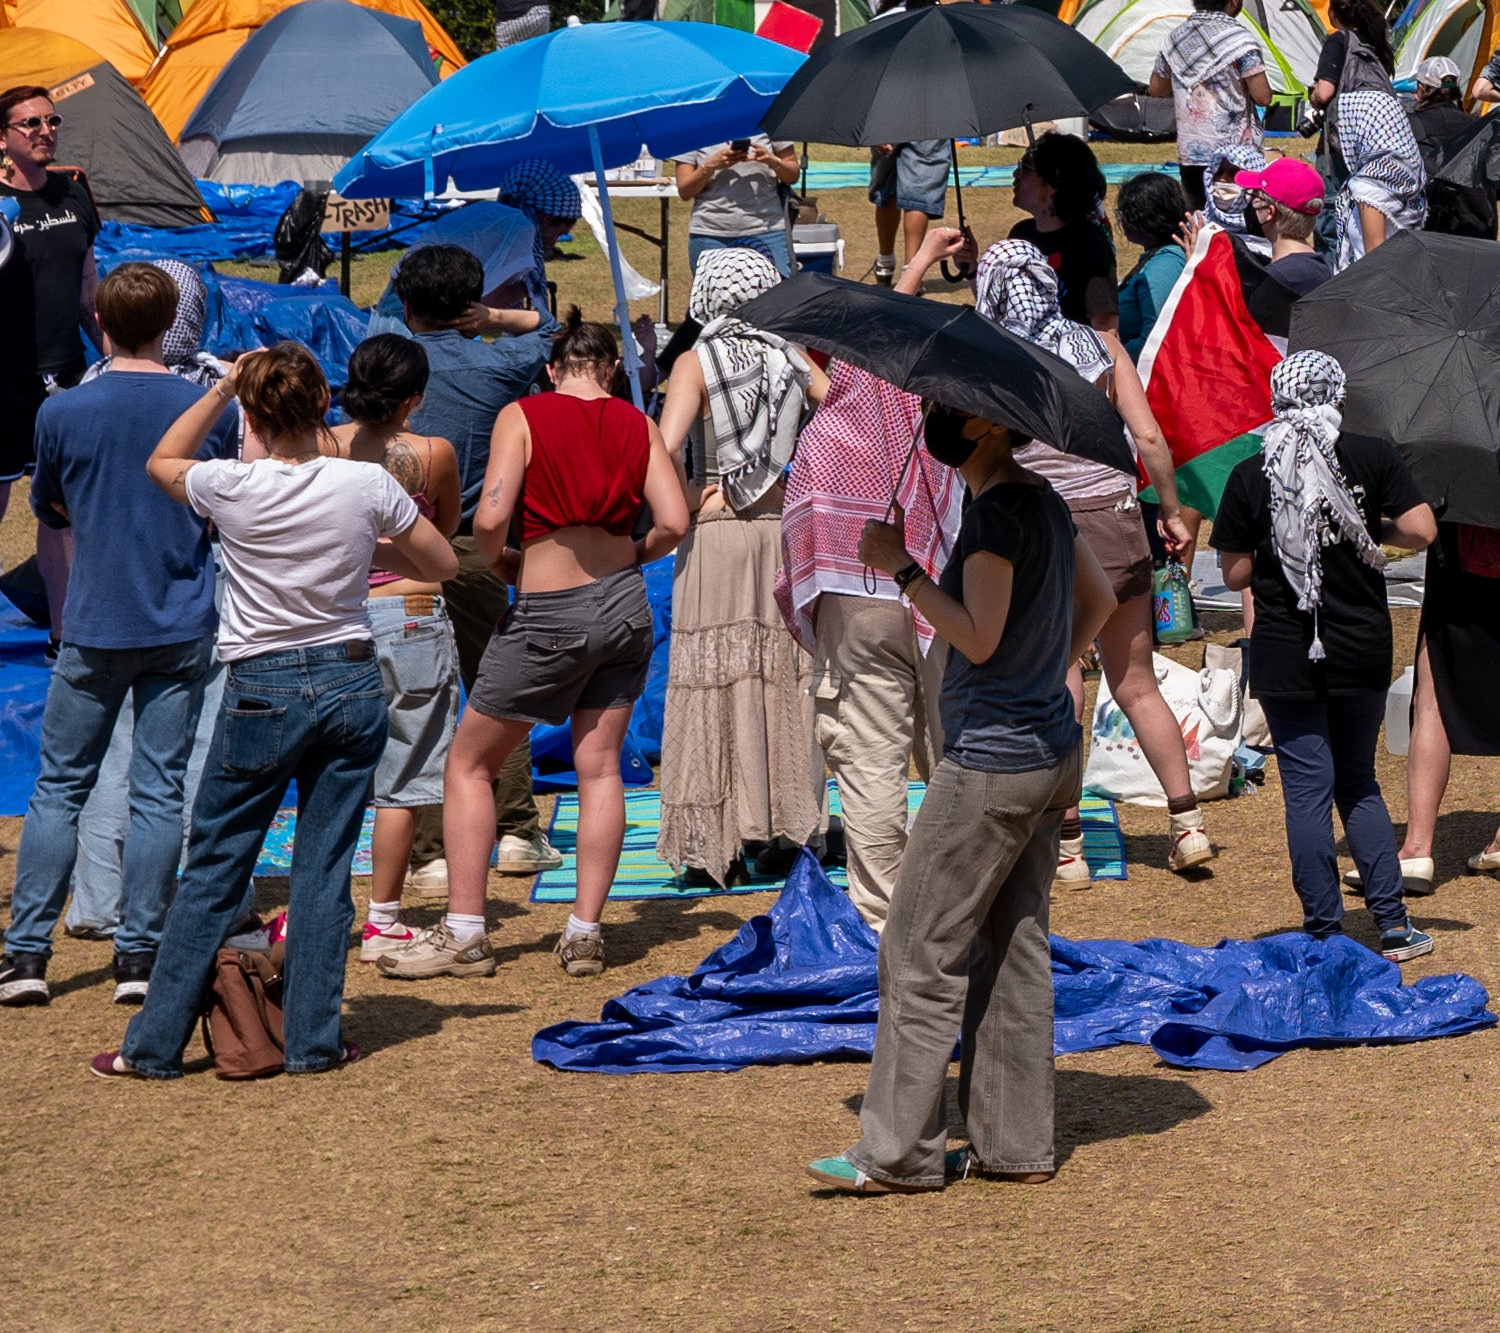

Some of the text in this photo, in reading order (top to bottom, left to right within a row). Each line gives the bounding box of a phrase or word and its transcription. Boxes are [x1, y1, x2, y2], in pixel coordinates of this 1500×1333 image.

[13, 209, 77, 235] فلسطين حرة
[328, 197, 388, 228] TRASH
